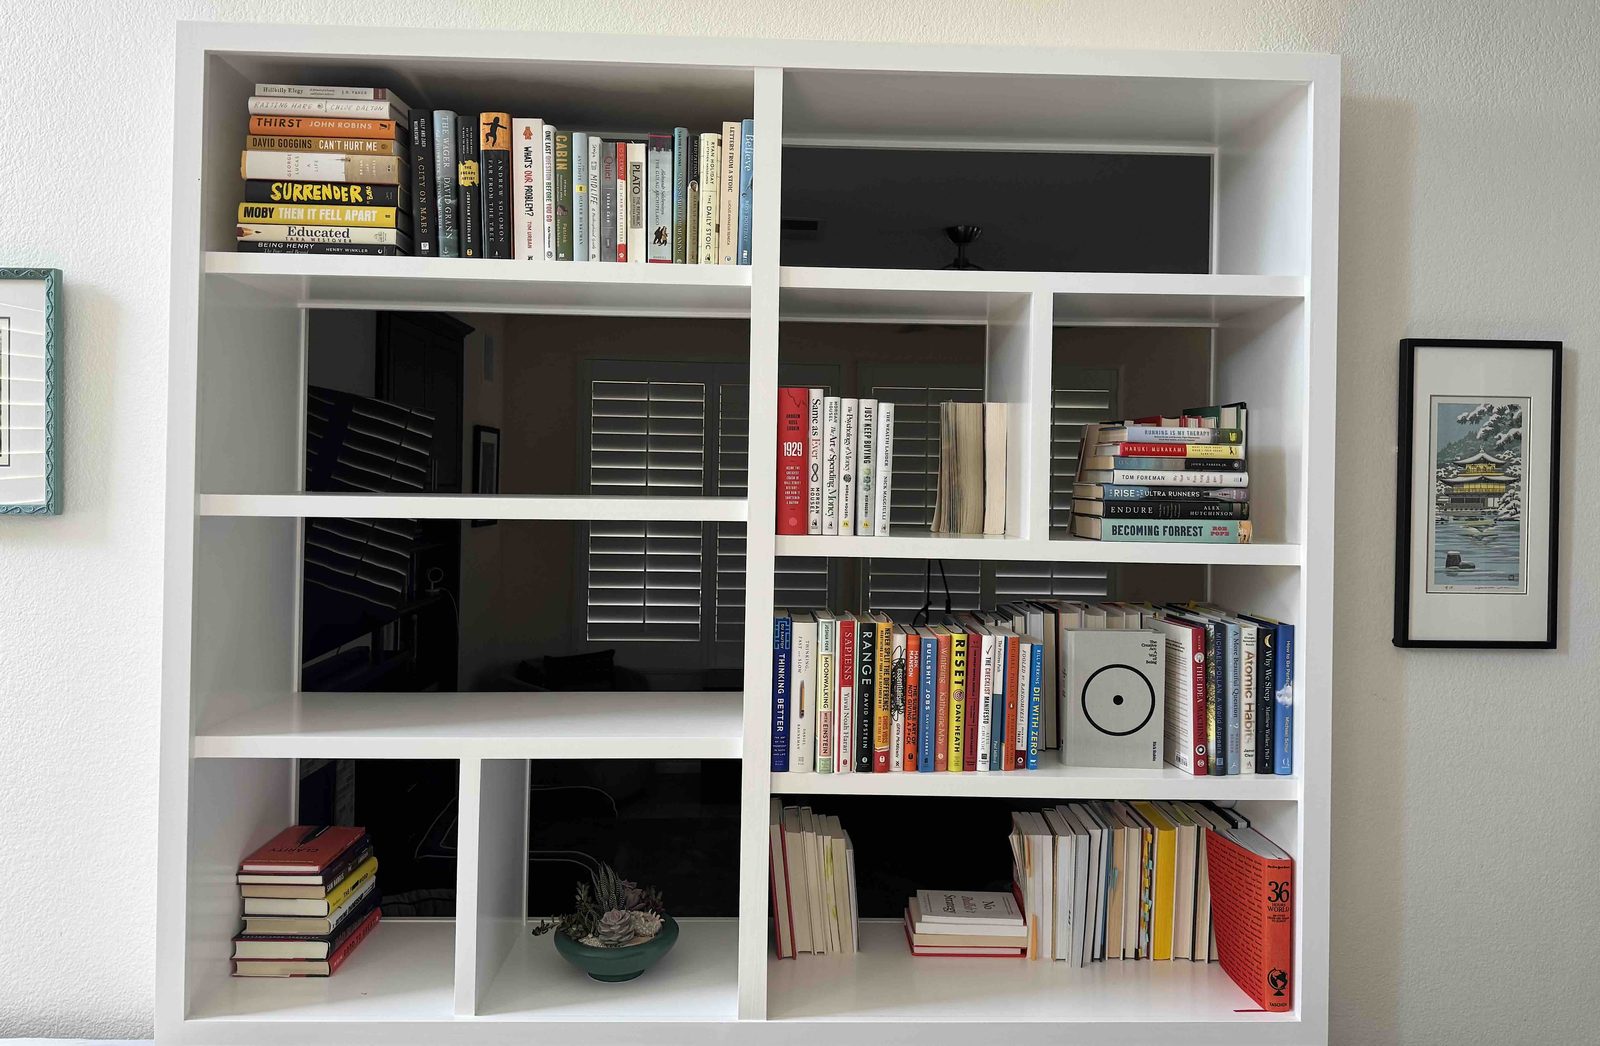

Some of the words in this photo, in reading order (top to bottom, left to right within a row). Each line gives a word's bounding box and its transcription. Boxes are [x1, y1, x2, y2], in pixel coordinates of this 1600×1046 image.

[257, 118, 302, 127] THIRST
[252, 139, 275, 147] DAVID
[278, 140, 312, 148] GOGGINS
[319, 140, 341, 149] CAN'T
[344, 141, 363, 150] HURT
[366, 142, 377, 150] ME
[556, 135, 567, 170] CABIN
[744, 134, 753, 171] Believe
[524, 147, 532, 168] WHAT'S
[604, 156, 613, 180] Quiet
[271, 183, 363, 202] SURRENDER
[420, 191, 426, 203] ON
[524, 185, 534, 216] PROBLEM?
[243, 207, 274, 218] MOBY
[279, 208, 304, 218] THEN
[307, 209, 316, 219] IT
[320, 209, 341, 220] FELL
[345, 210, 377, 221] APART
[444, 207, 452, 239] GRANN
[287, 227, 350, 238] Educated
[812, 399, 821, 423] Same
[812, 426, 818, 436] as
[844, 414, 853, 445] Psychology
[784, 442, 802, 456] 1929
[812, 439, 820, 459] Ever
[829, 435, 837, 447] Art
[827, 454, 836, 487] Spending
[825, 489, 836, 518] Money
[1112, 525, 1159, 536] BECOMING
[1163, 526, 1203, 536] FORREST
[844, 632, 852, 680] SAPIENS
[862, 632, 872, 685] RANGE
[939, 648, 947, 683] Wintering
[955, 640, 965, 686] RESET
[1264, 650, 1272, 668] Why
[1244, 651, 1255, 698] Atomic
[1265, 670, 1272, 680] We
[1263, 682, 1271, 701] Sleep
[938, 692, 946, 726] Katherine
[912, 736, 916, 745] OF
[1268, 880, 1290, 902] 36
